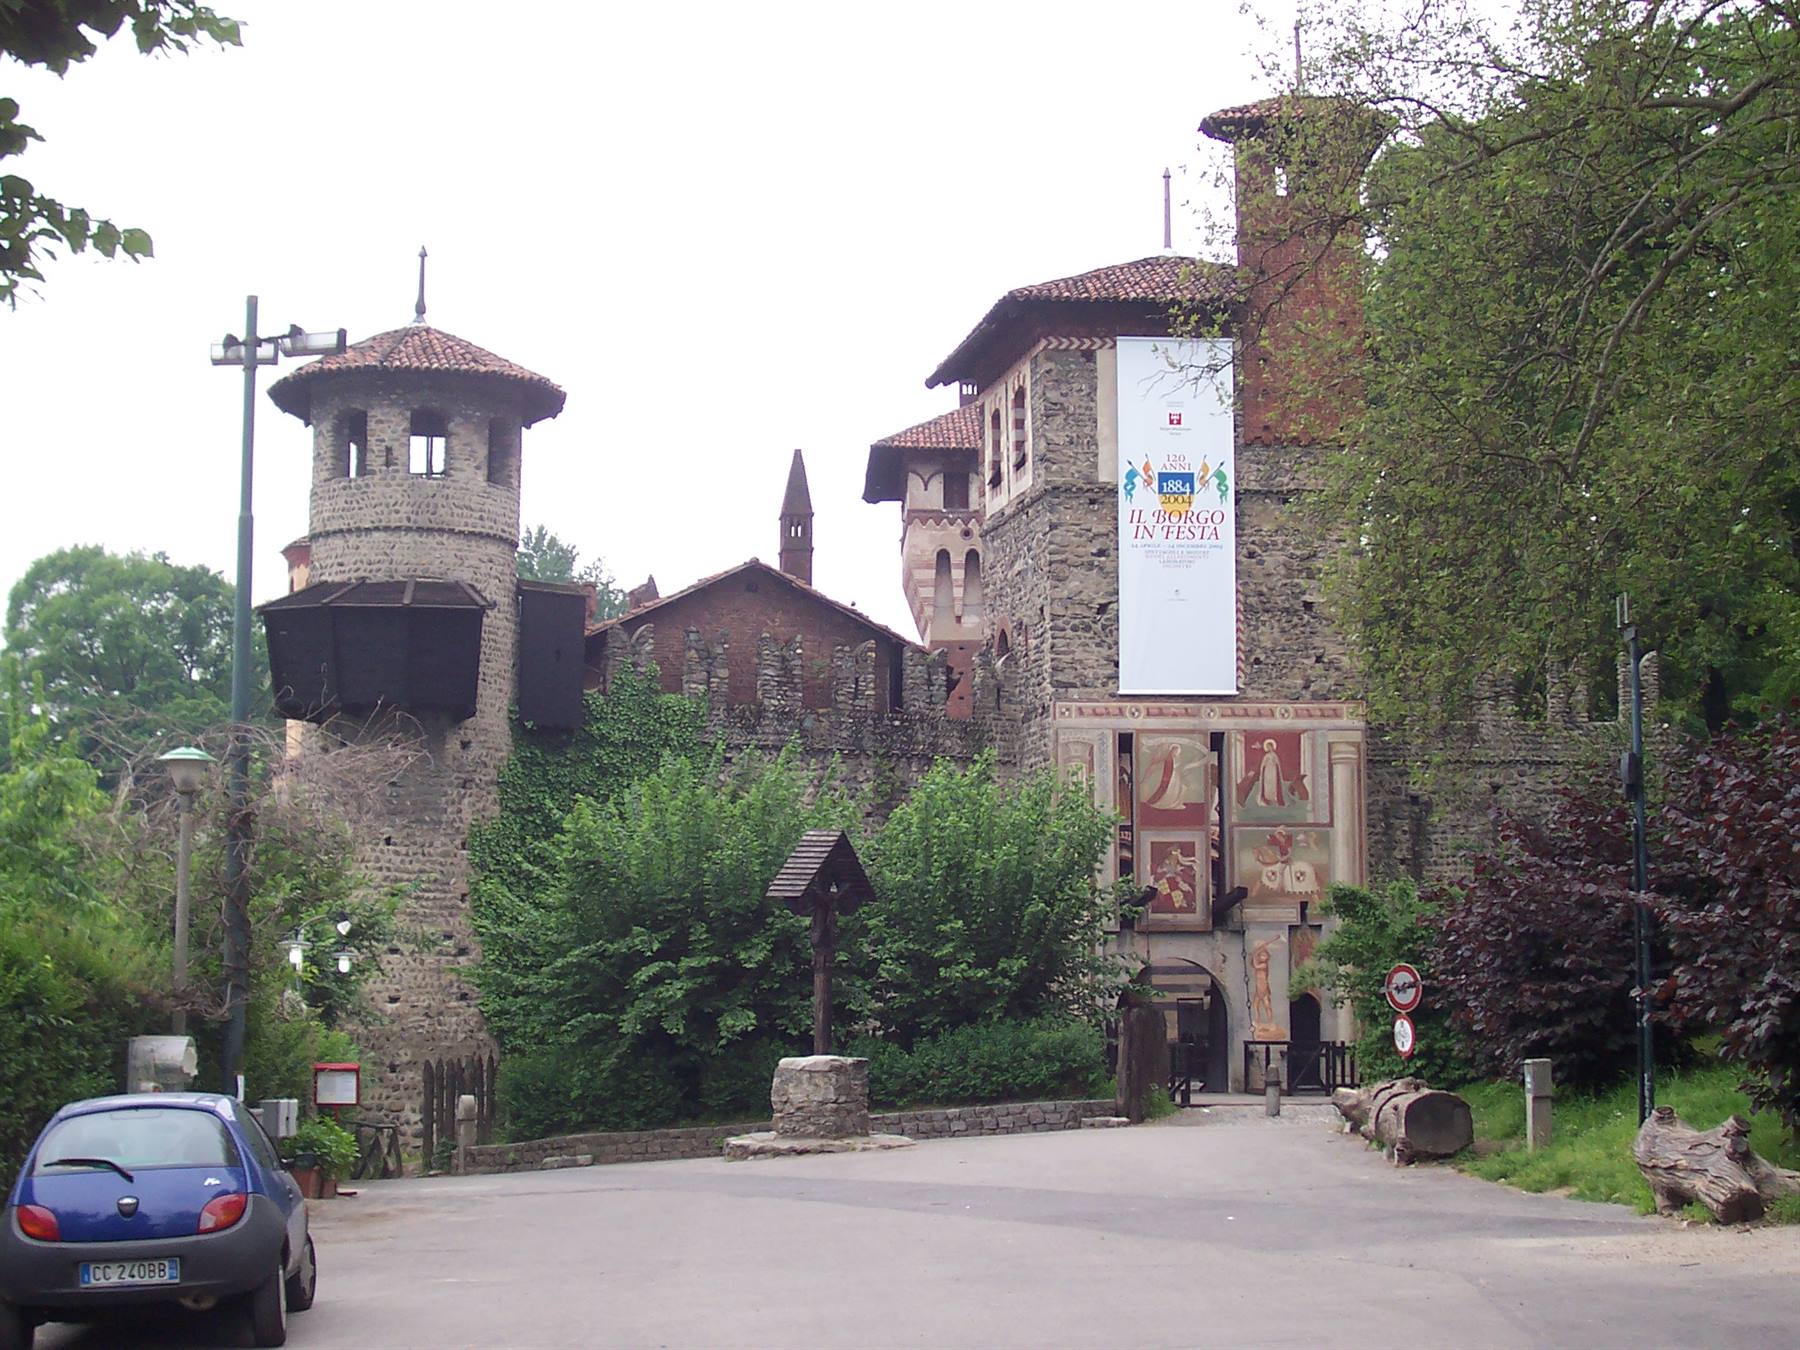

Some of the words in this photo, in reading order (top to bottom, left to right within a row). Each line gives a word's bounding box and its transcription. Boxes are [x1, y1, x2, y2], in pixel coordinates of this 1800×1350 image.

[1166, 454, 1186, 462] 120
[1161, 463, 1191, 471] ANNI
[1162, 480, 1191, 495] 1884
[1161, 495, 1192, 507] 2004
[1129, 509, 1146, 524] IL
[1152, 509, 1225, 525] BORGO
[1134, 525, 1156, 539] IN
[1161, 525, 1220, 540] FESTA
[92, 1265, 111, 1282] CC
[116, 1262, 167, 1280] 240BB
